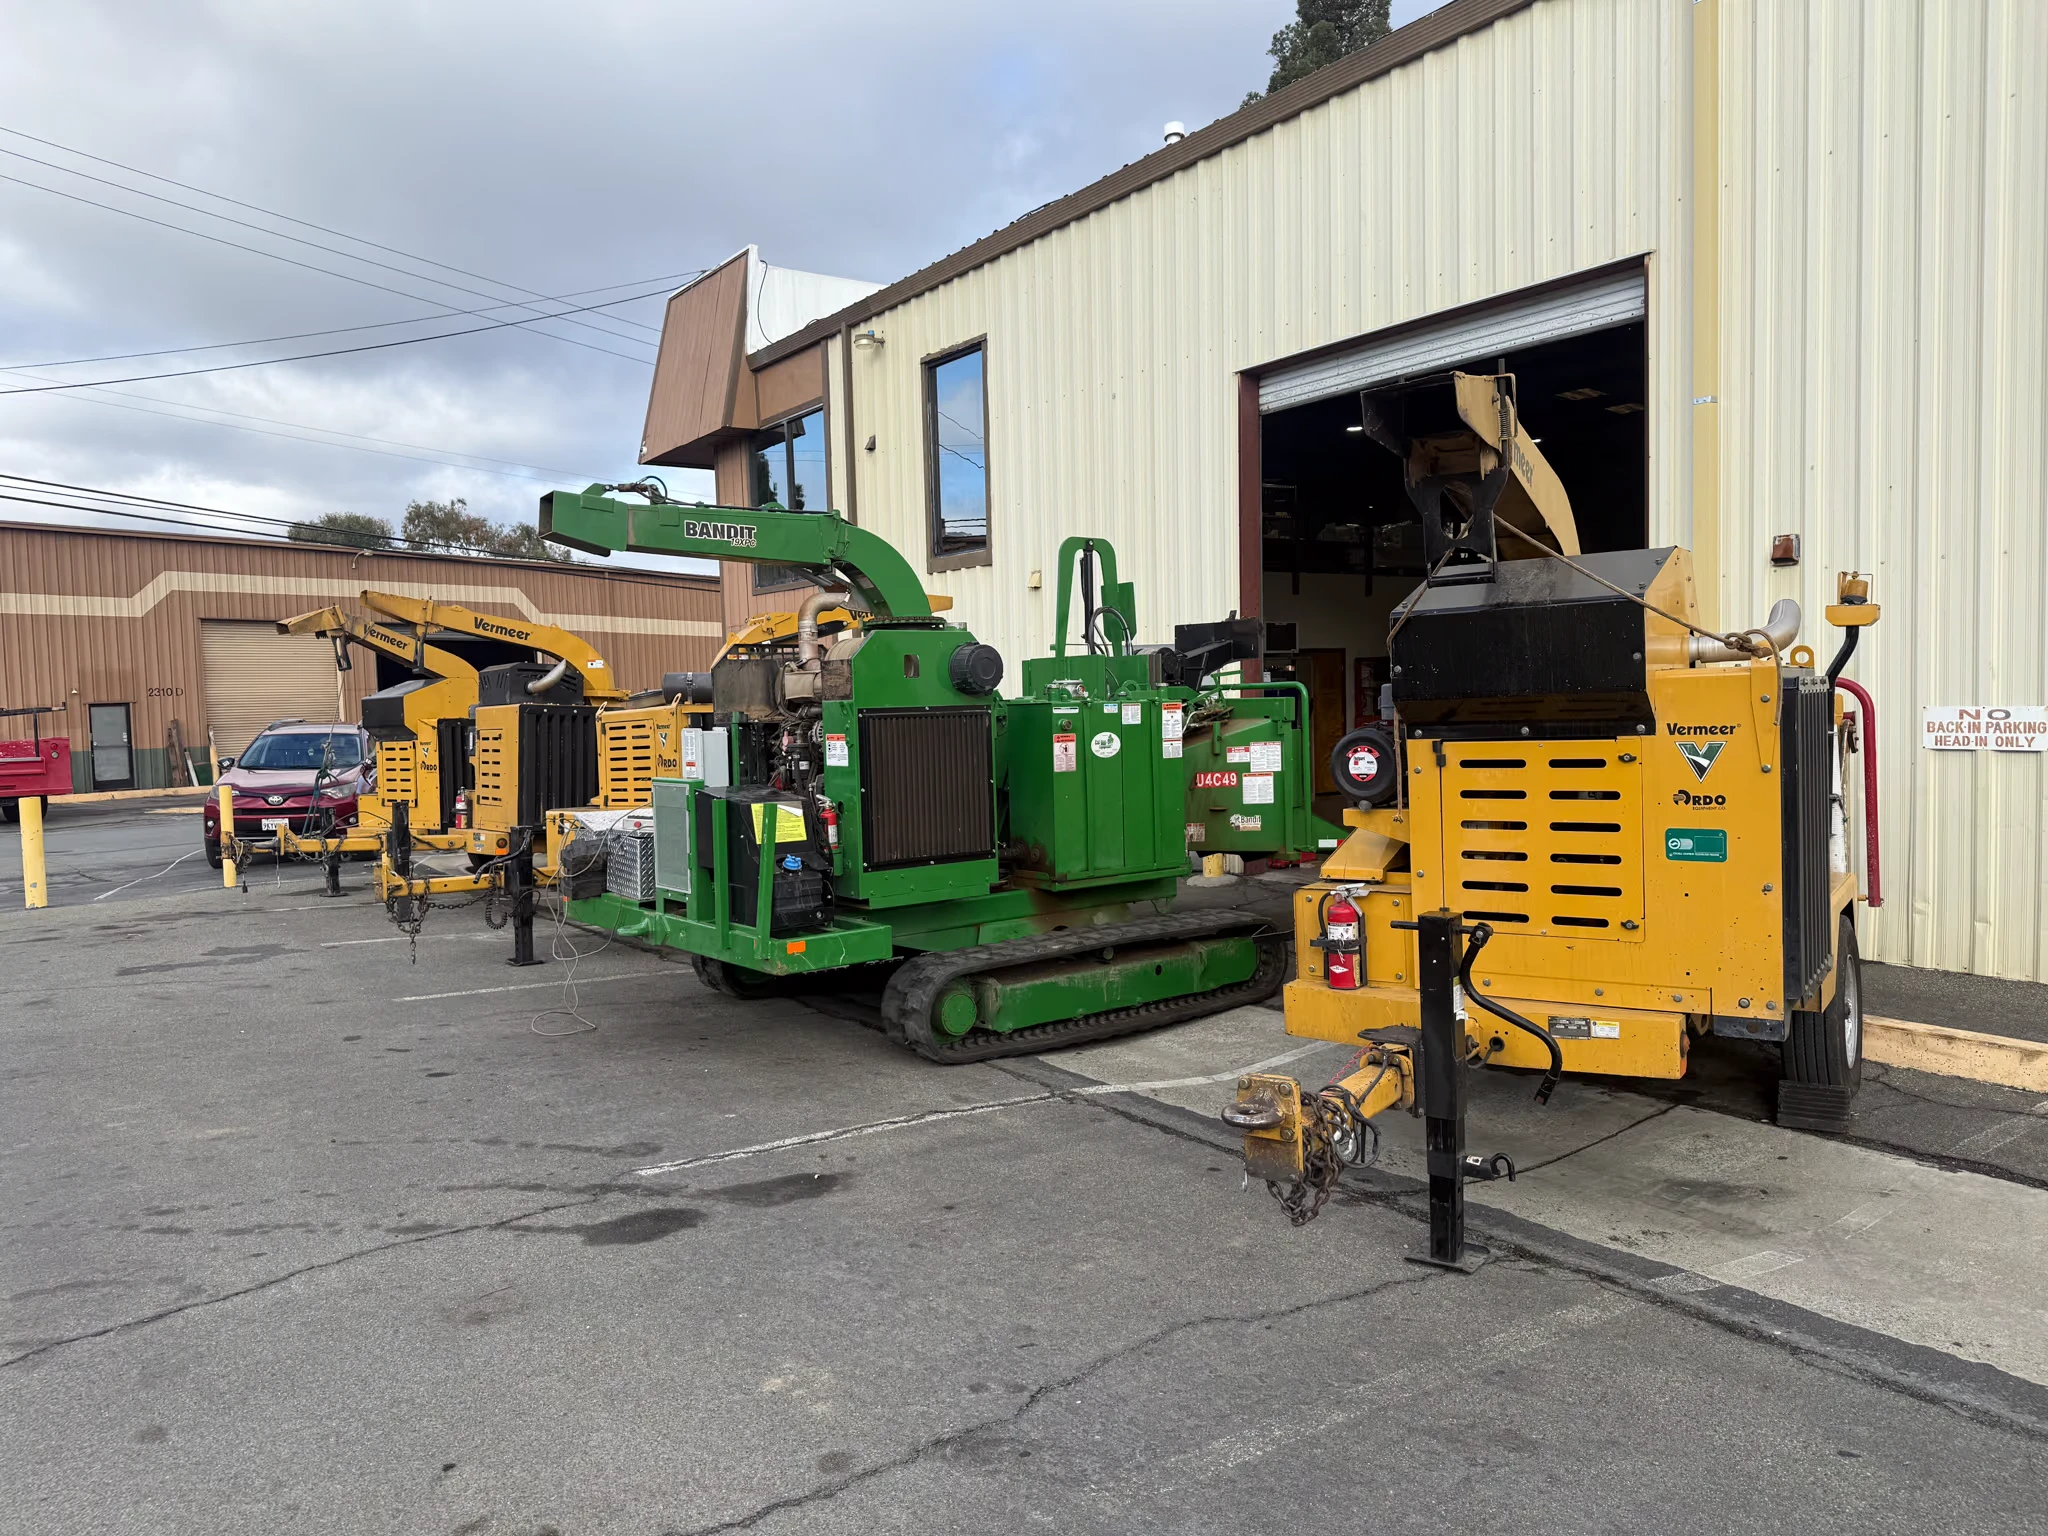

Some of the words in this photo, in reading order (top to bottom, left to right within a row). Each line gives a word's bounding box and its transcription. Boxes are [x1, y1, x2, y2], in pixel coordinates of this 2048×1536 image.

[1513, 440, 1533, 488] meer
[684, 520, 757, 540] BANDIT
[474, 616, 531, 641] Vermeer
[364, 623, 409, 650] Vermeer
[148, 687, 173, 697] 2310
[175, 687, 184, 697] D
[1958, 708, 2011, 721] NO
[1666, 722, 1736, 736] Vermeer
[1985, 721, 2047, 734] PARKING
[1995, 736, 2036, 748] ONLY
[1196, 772, 1237, 787] U4C49
[1240, 814, 1261, 824] Bandit
